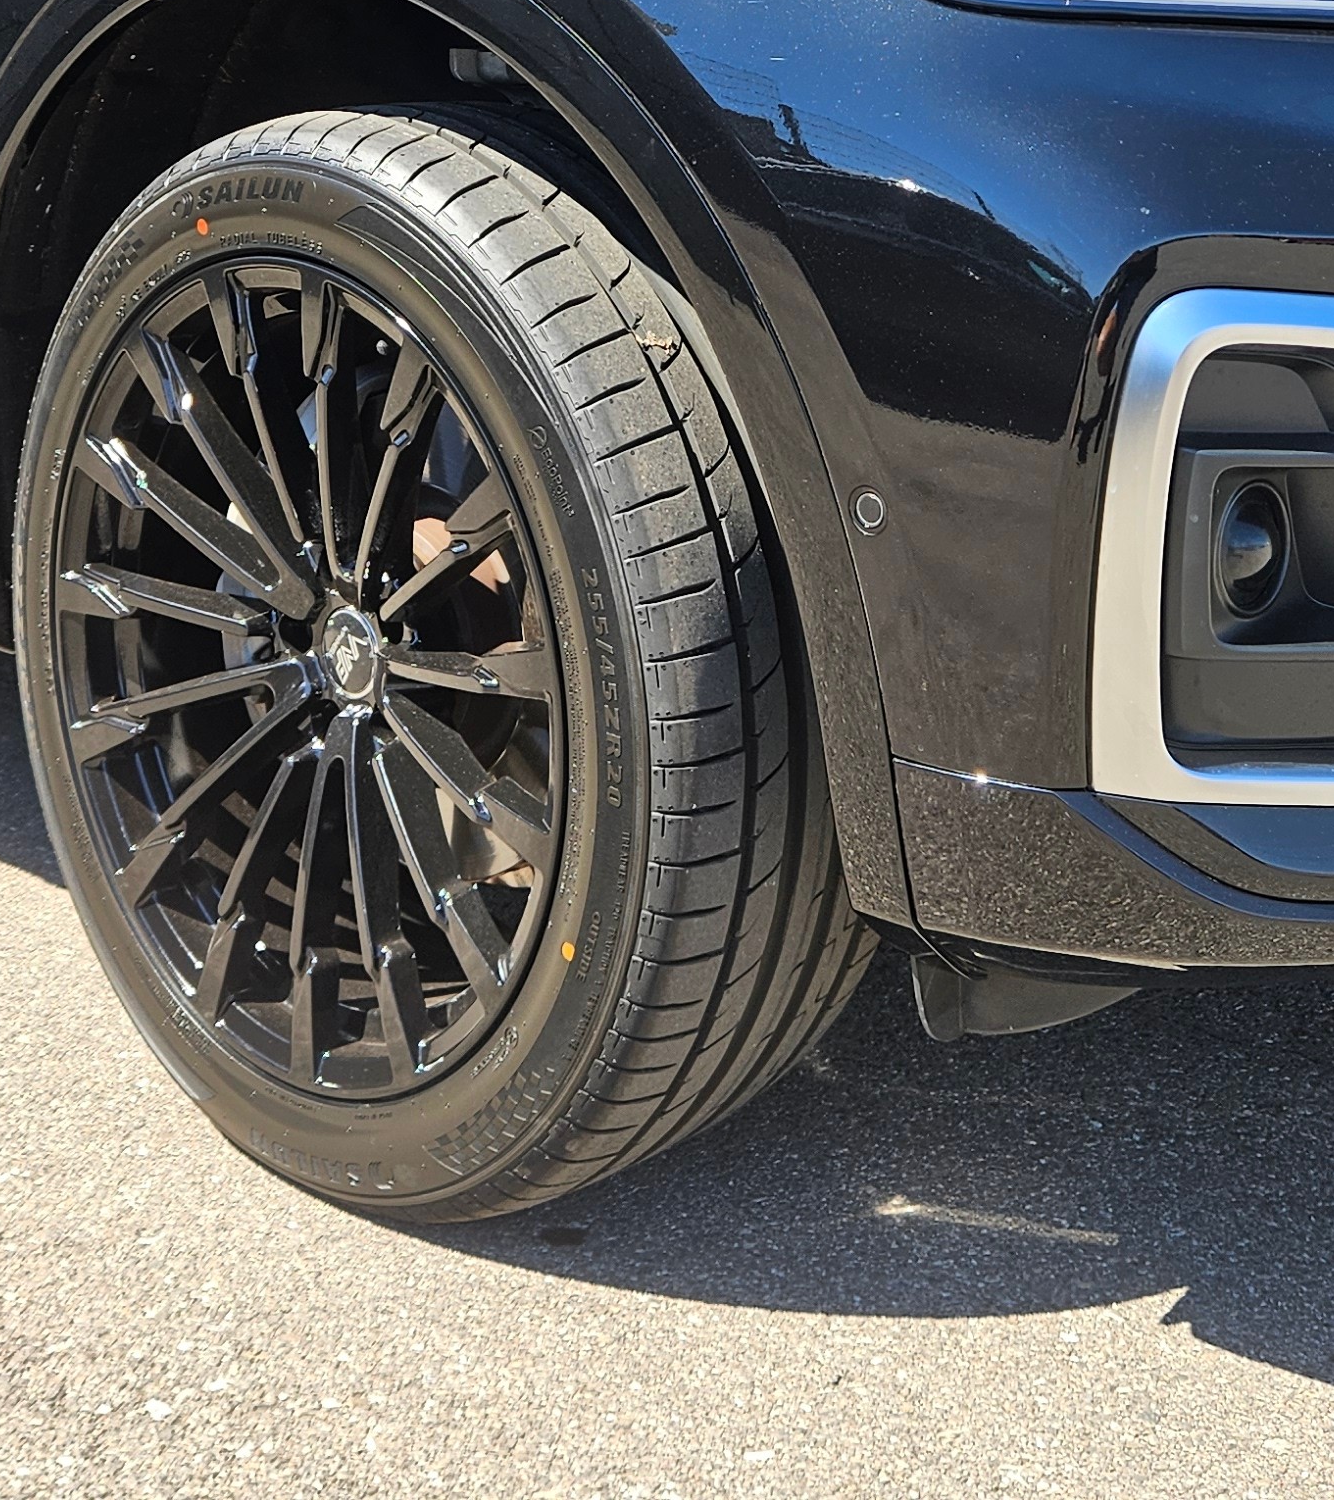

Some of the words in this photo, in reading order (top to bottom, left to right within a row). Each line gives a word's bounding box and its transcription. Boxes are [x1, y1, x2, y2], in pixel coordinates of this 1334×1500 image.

[196, 176, 306, 210] SAILUN
[219, 231, 259, 248] RADIAL
[575, 911, 603, 984] OUTSIDE
[249, 1127, 361, 1187] SAILUN
